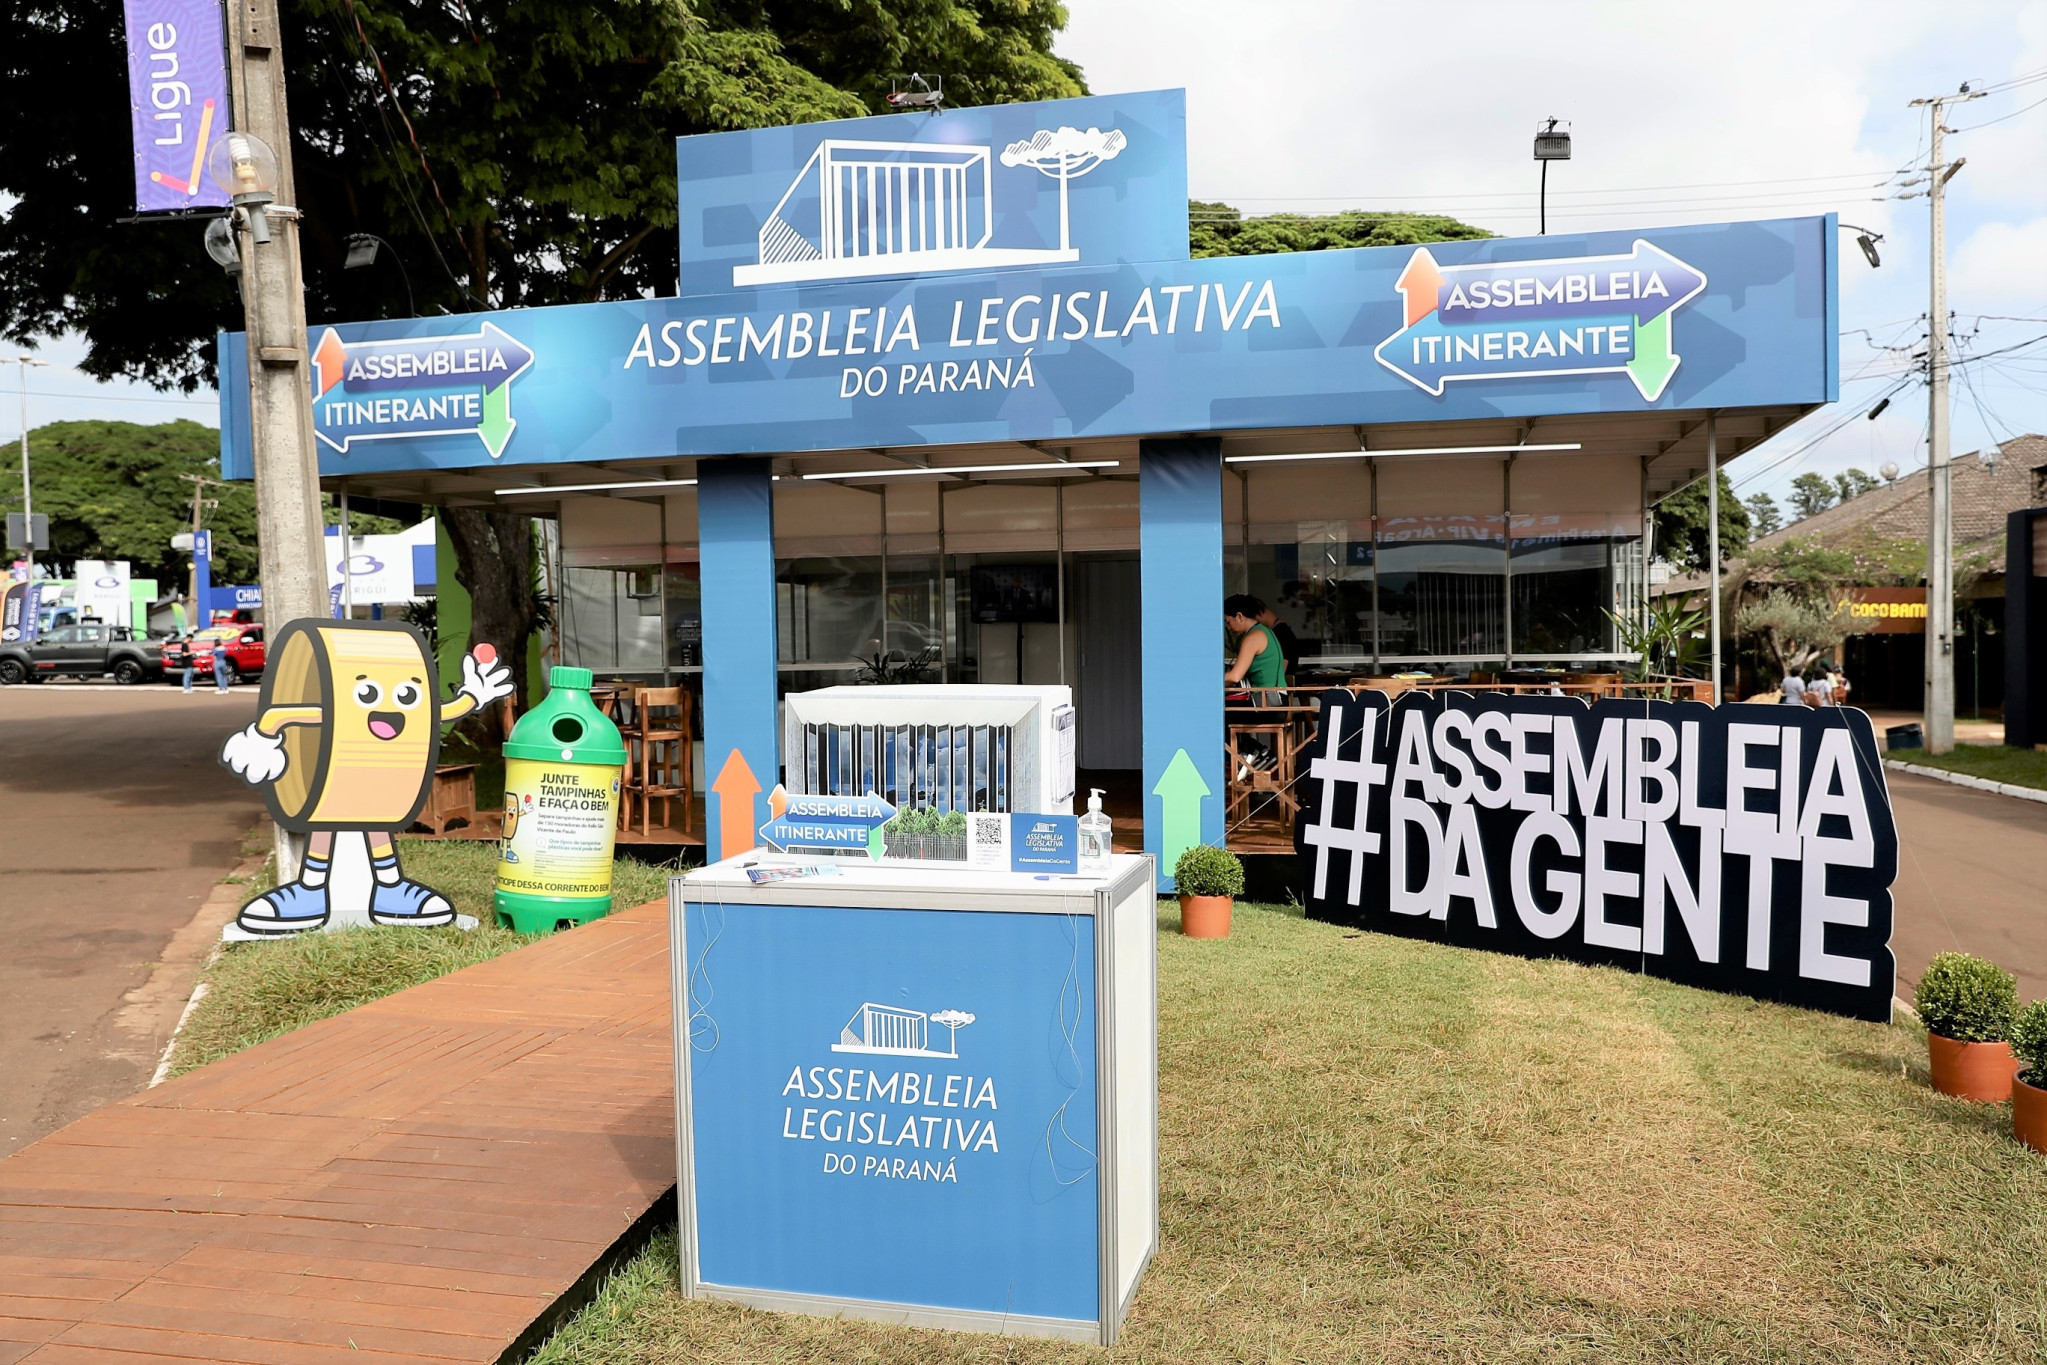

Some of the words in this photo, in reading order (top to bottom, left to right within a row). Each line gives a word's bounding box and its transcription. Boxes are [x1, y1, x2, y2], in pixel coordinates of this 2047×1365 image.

[148, 20, 192, 146] Ligue
[1444, 270, 1670, 312] ASSEMBLEIA
[623, 302, 920, 369] ASSEMBLEIA
[948, 279, 1283, 347] LEGISLATIVA
[1412, 324, 1631, 366] ITINERANTE
[346, 346, 508, 382] ASSEMBLEIA
[839, 365, 888, 399] DO
[897, 347, 1035, 395] PARANÁ
[324, 394, 481, 427] ITINERANTE
[235, 588, 262, 602] CHIA
[540, 773, 579, 785] JUNTE
[540, 785, 606, 799] TAMPINHAS
[539, 797, 546, 808] E
[547, 798, 579, 812] FAÇA
[580, 800, 590, 811] O
[590, 800, 609, 811] BEM
[788, 802, 883, 819] ASSEMBLEIA
[775, 825, 867, 842] ITINERANTE
[1025, 840, 1064, 848] LEGISLATIVA
[1026, 833, 1064, 841] ASSEMBLEIA
[517, 880, 543, 890] DESSA
[545, 883, 589, 892] CORRENTE
[589, 884, 599, 893] DO
[1389, 795, 1498, 930] DA
[1510, 810, 1872, 988] GENTE
[782, 1065, 999, 1111] ASSEMBLEIA
[782, 1107, 1000, 1154] LEGISLATIVA
[823, 1153, 858, 1176] DO
[863, 1155, 958, 1184] PARANÁ
